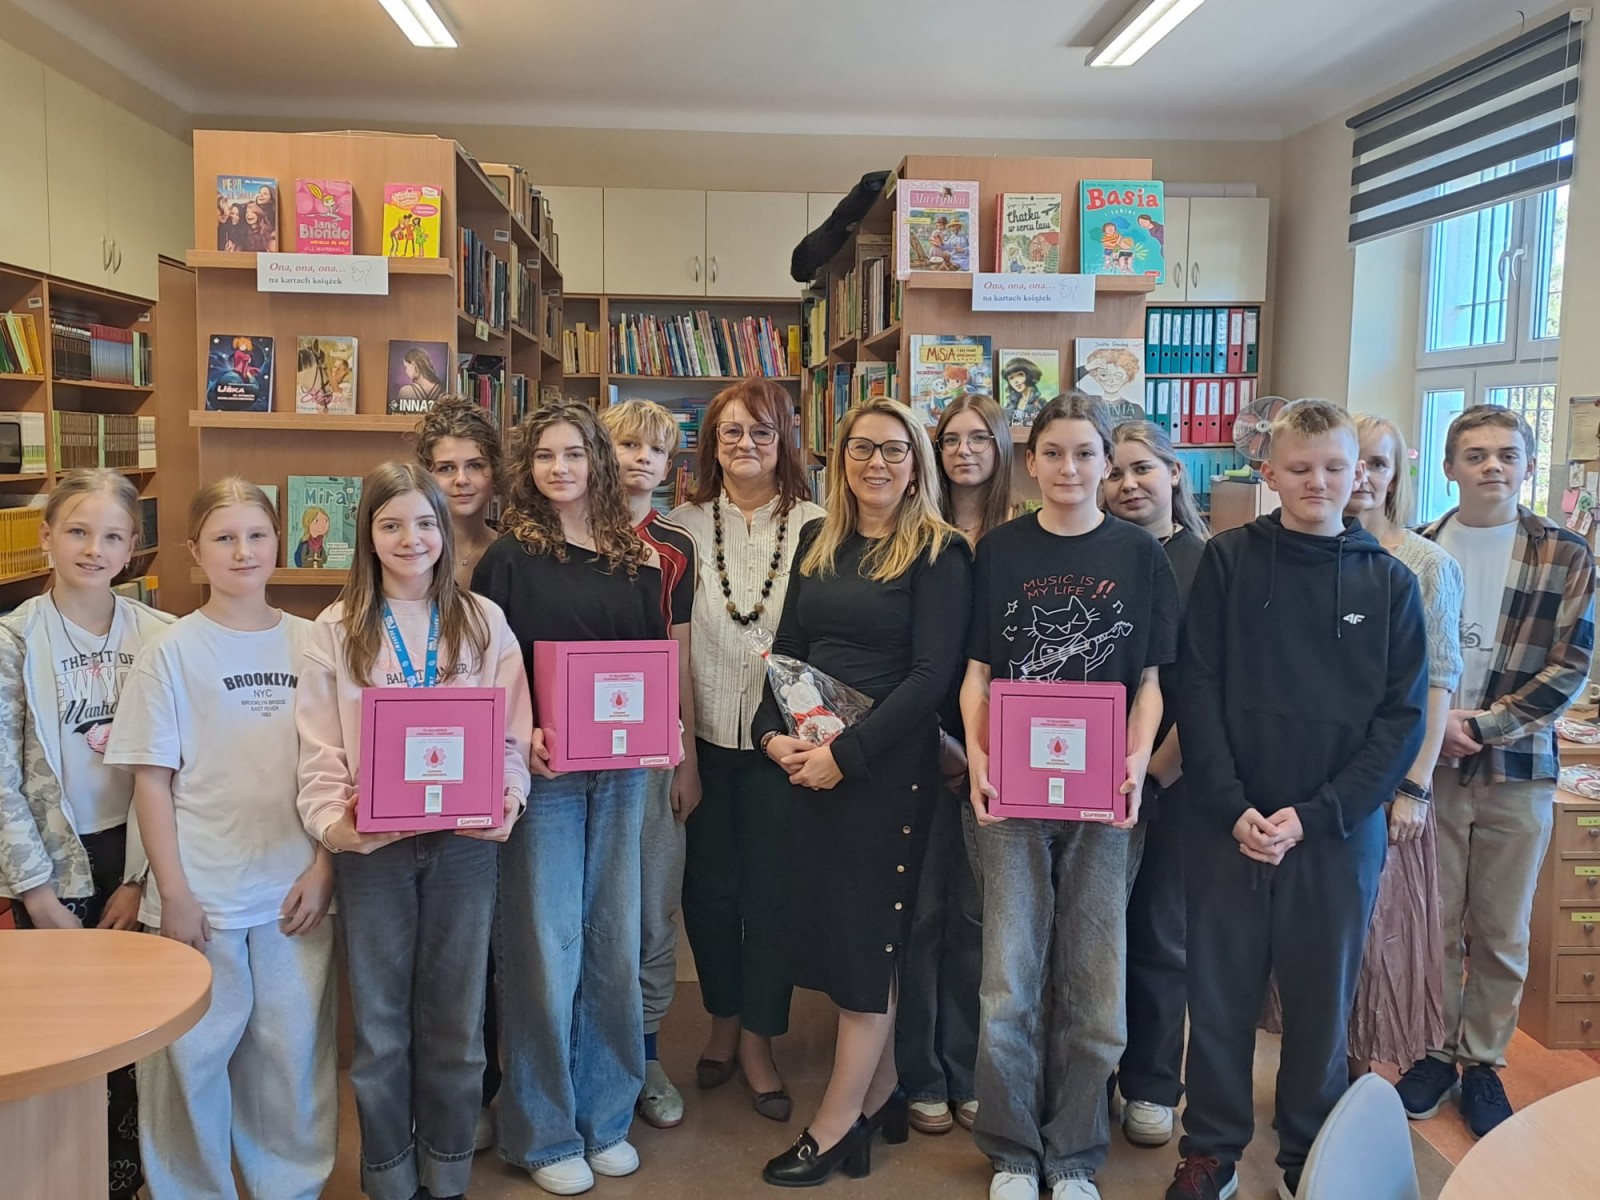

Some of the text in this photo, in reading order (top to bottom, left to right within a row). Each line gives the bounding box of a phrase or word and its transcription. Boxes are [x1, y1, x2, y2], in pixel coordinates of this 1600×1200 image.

[1086, 188, 1160, 211] Basia
[1007, 207, 1041, 224] Chatka
[313, 219, 338, 229] Jane
[1035, 219, 1051, 230] lasu
[299, 223, 350, 240] Blonde
[269, 262, 293, 273] Ona,
[294, 264, 316, 273] ona,
[280, 275, 311, 285] kartach
[312, 276, 343, 287] książek
[983, 281, 1005, 291] Ona,
[1007, 283, 1027, 291] ona,
[994, 294, 1022, 302] kartach
[1023, 294, 1052, 304] książek
[399, 398, 435, 412] INNA?
[304, 487, 348, 506] Mira
[1023, 574, 1096, 591] MUSIC IS
[1027, 587, 1049, 600] MY
[1054, 586, 1085, 596] LIFE
[61, 653, 89, 672] THE
[118, 653, 136, 665] OF
[222, 672, 299, 691] BROOKLYN
[385, 669, 424, 685] BALT
[253, 688, 273, 698] NYC
